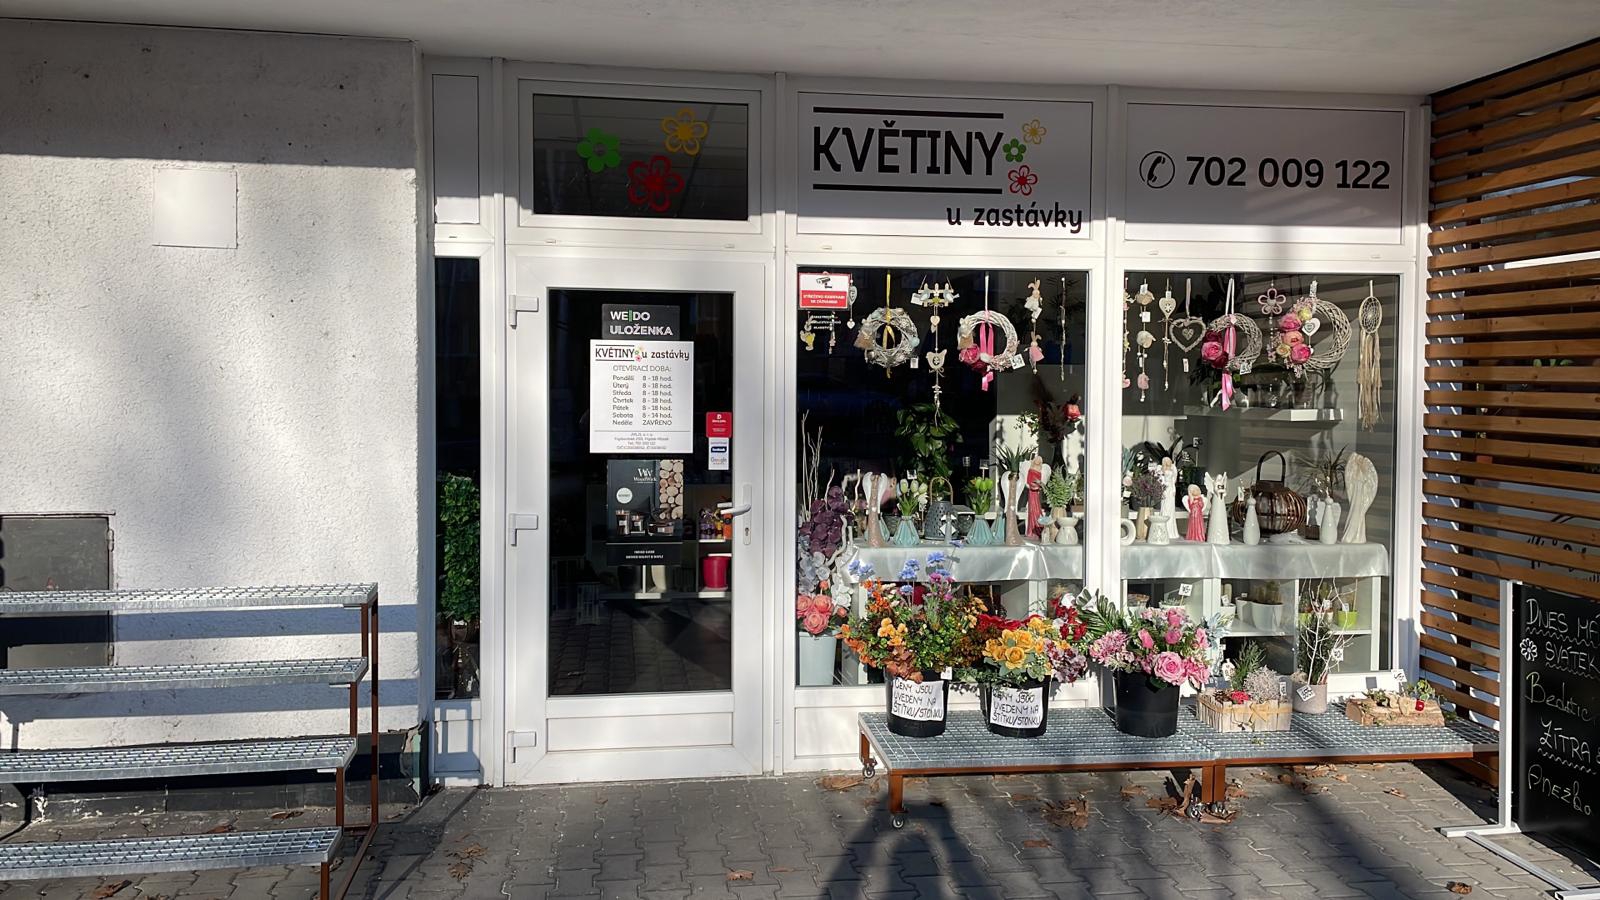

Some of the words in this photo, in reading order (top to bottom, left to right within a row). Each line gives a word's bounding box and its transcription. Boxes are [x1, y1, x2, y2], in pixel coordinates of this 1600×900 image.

[812, 119, 1004, 176] KVĚTINY
[1186, 156, 1247, 187] 702
[1257, 157, 1324, 188] 009
[1334, 159, 1391, 189] 122
[946, 207, 962, 227] u
[973, 201, 1083, 234] zastávky
[609, 323, 674, 336] ULOŽENKA
[595, 347, 635, 358] KVĚTINY
[651, 350, 690, 361] zastávky
[612, 364, 649, 372] OTEVÍRACÍ
[1526, 598, 1569, 633] DNES
